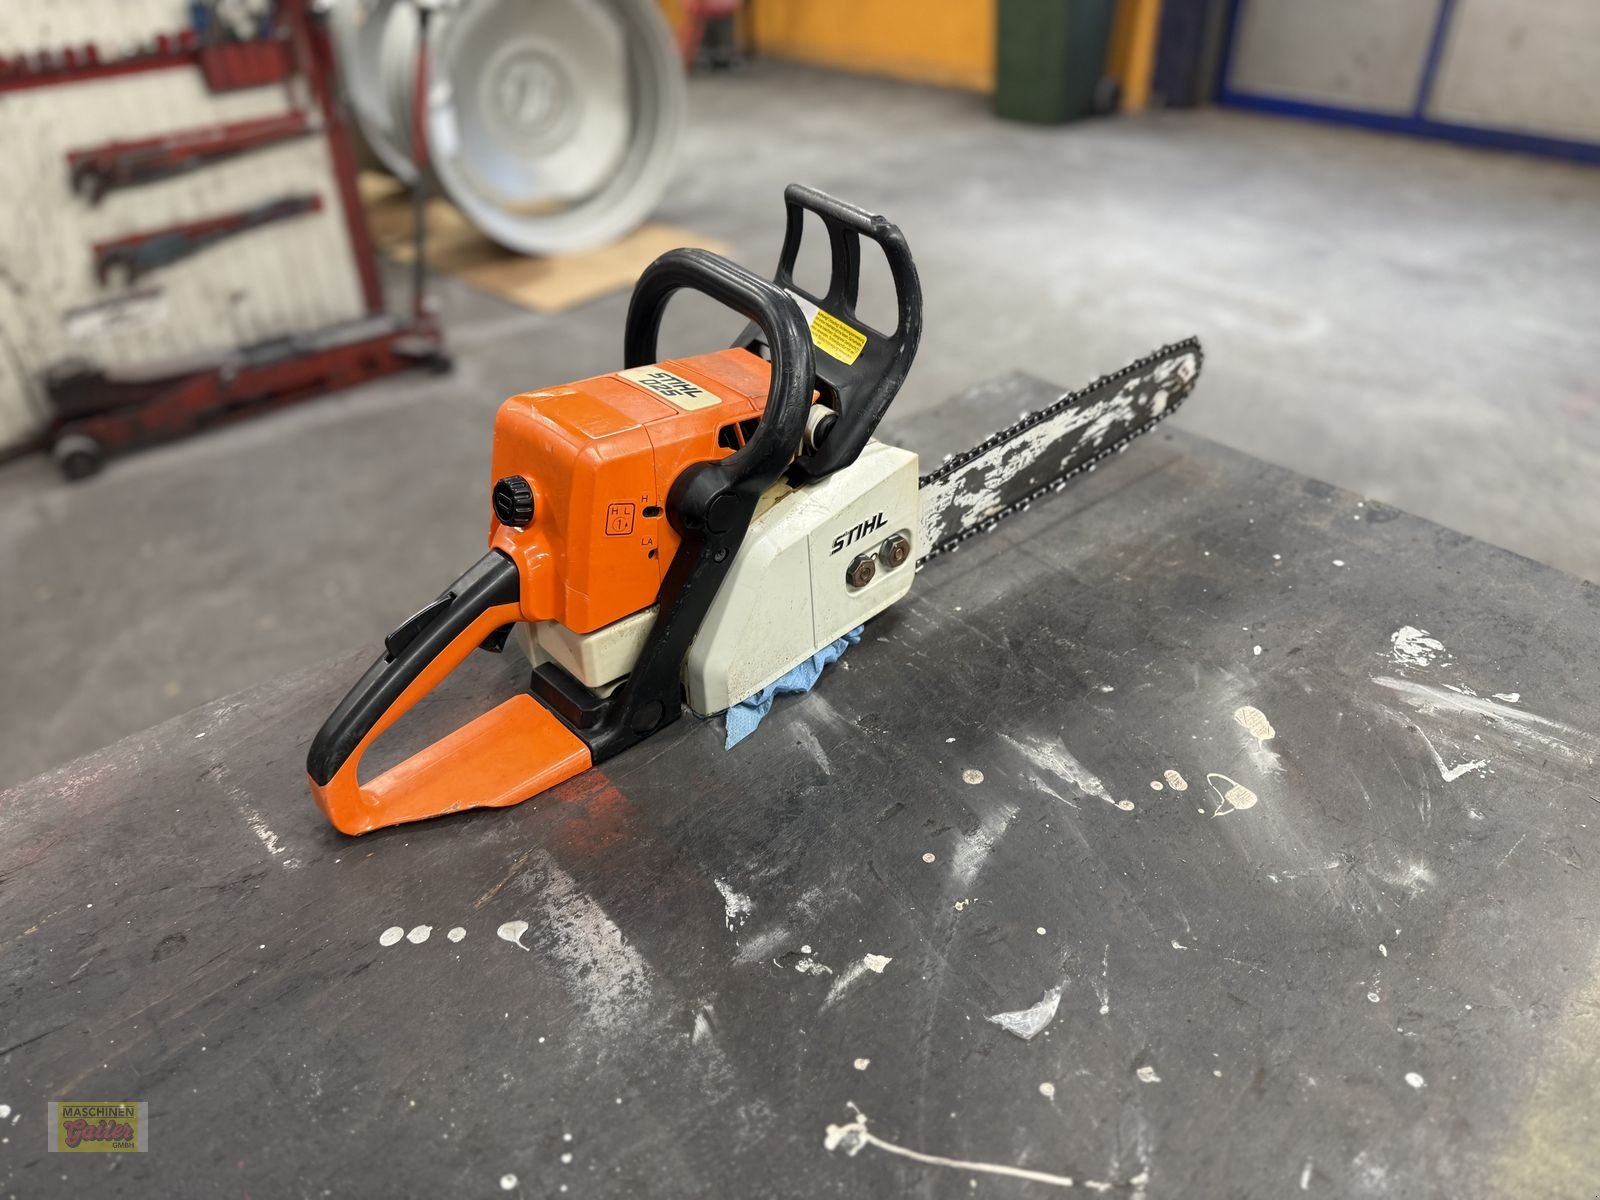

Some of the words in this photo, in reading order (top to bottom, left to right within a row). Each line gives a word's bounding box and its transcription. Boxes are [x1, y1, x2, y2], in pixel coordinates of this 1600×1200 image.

[638, 379, 684, 397] 025
[648, 372, 703, 398] STIHL
[641, 495, 649, 503] H
[611, 507, 619, 515] H
[624, 507, 631, 515] L
[829, 511, 888, 555] STIHL
[641, 537, 653, 546] LA
